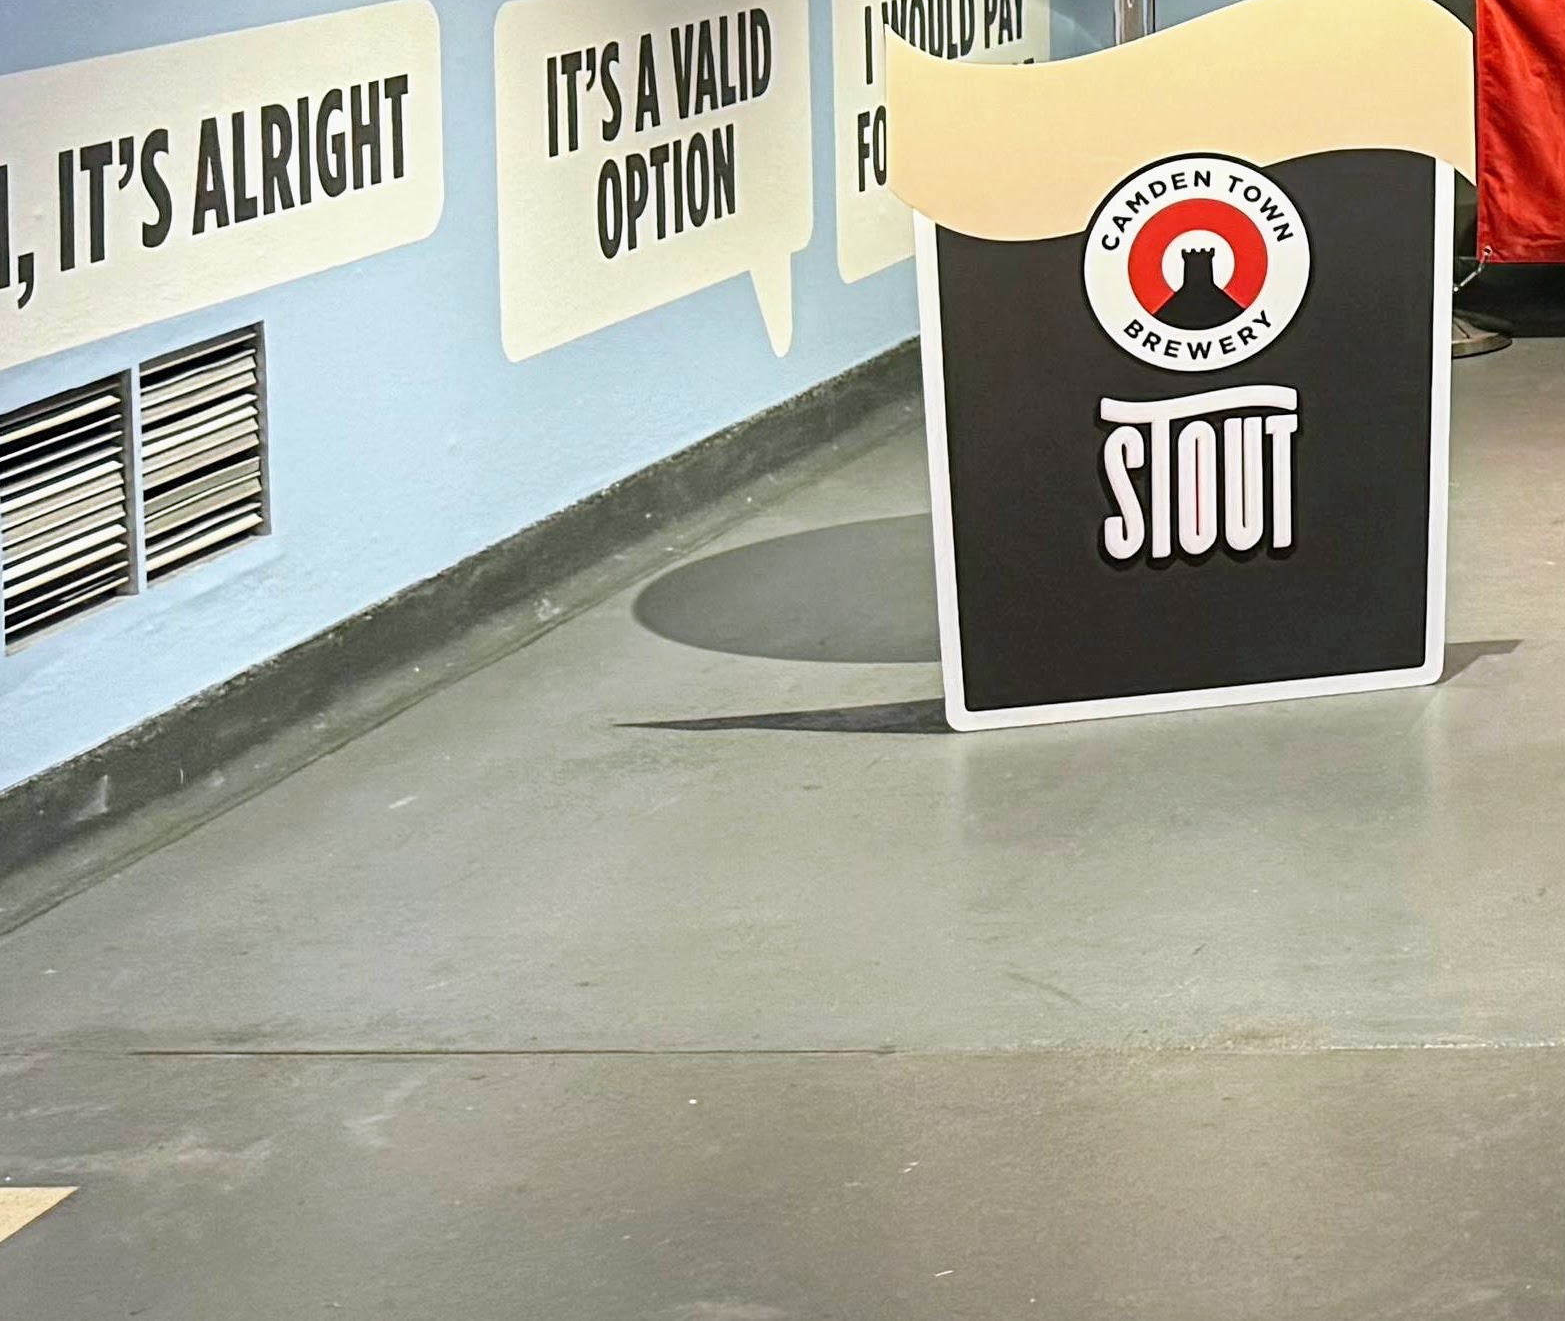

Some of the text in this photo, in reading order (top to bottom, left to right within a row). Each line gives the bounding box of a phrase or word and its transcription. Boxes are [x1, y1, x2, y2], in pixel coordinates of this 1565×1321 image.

[546, 7, 772, 159] IT'S A VALID
[865, 5, 873, 85] I
[59, 129, 172, 272] IT'S
[192, 74, 409, 237] ALRIGHT
[597, 124, 736, 259] OPTION
[1100, 169, 1294, 252] CAMDEN TOWN
[1122, 310, 1275, 360] BREWERY
[1100, 385, 1299, 561] STOUT
